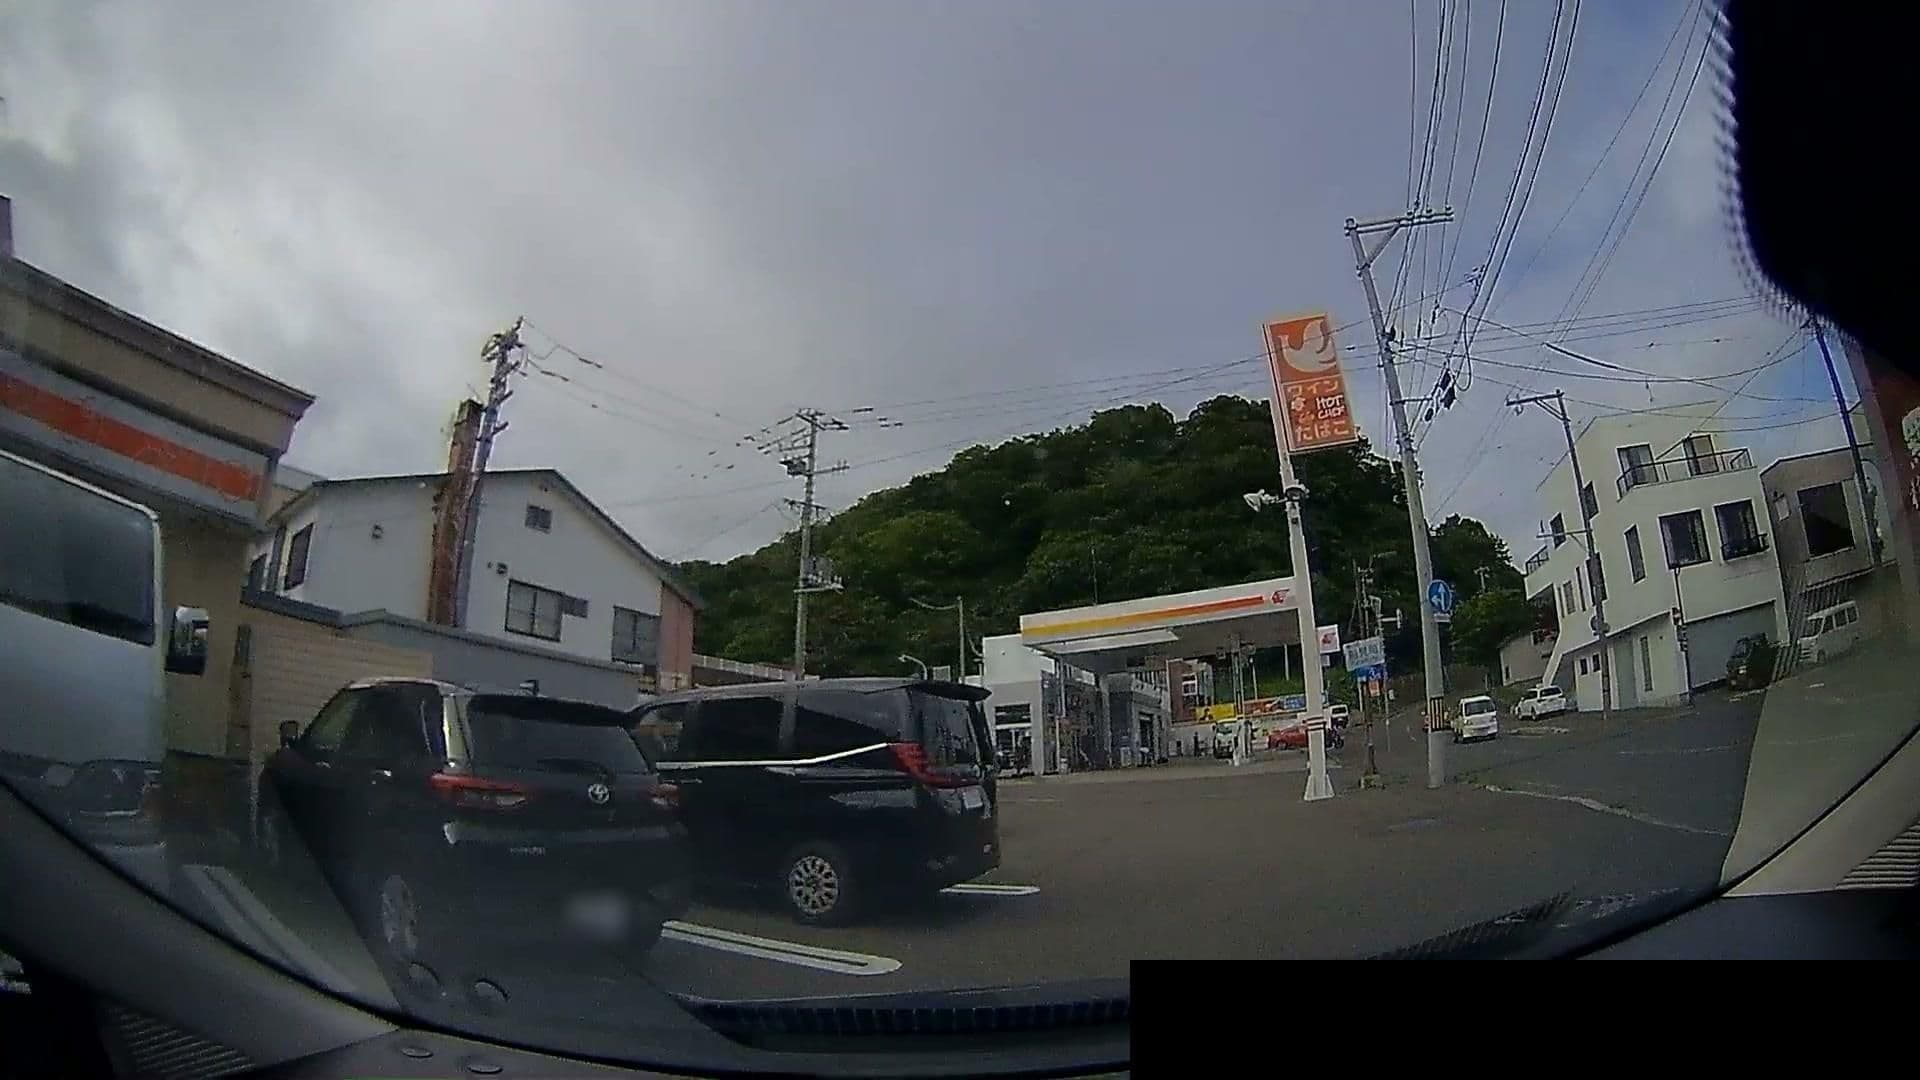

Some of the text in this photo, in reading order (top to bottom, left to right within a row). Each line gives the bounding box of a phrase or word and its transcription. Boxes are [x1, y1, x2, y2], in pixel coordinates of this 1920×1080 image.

[1287, 380, 1338, 397] ワイン
[1316, 394, 1343, 409] HOT
[1295, 420, 1349, 442] たばこ
